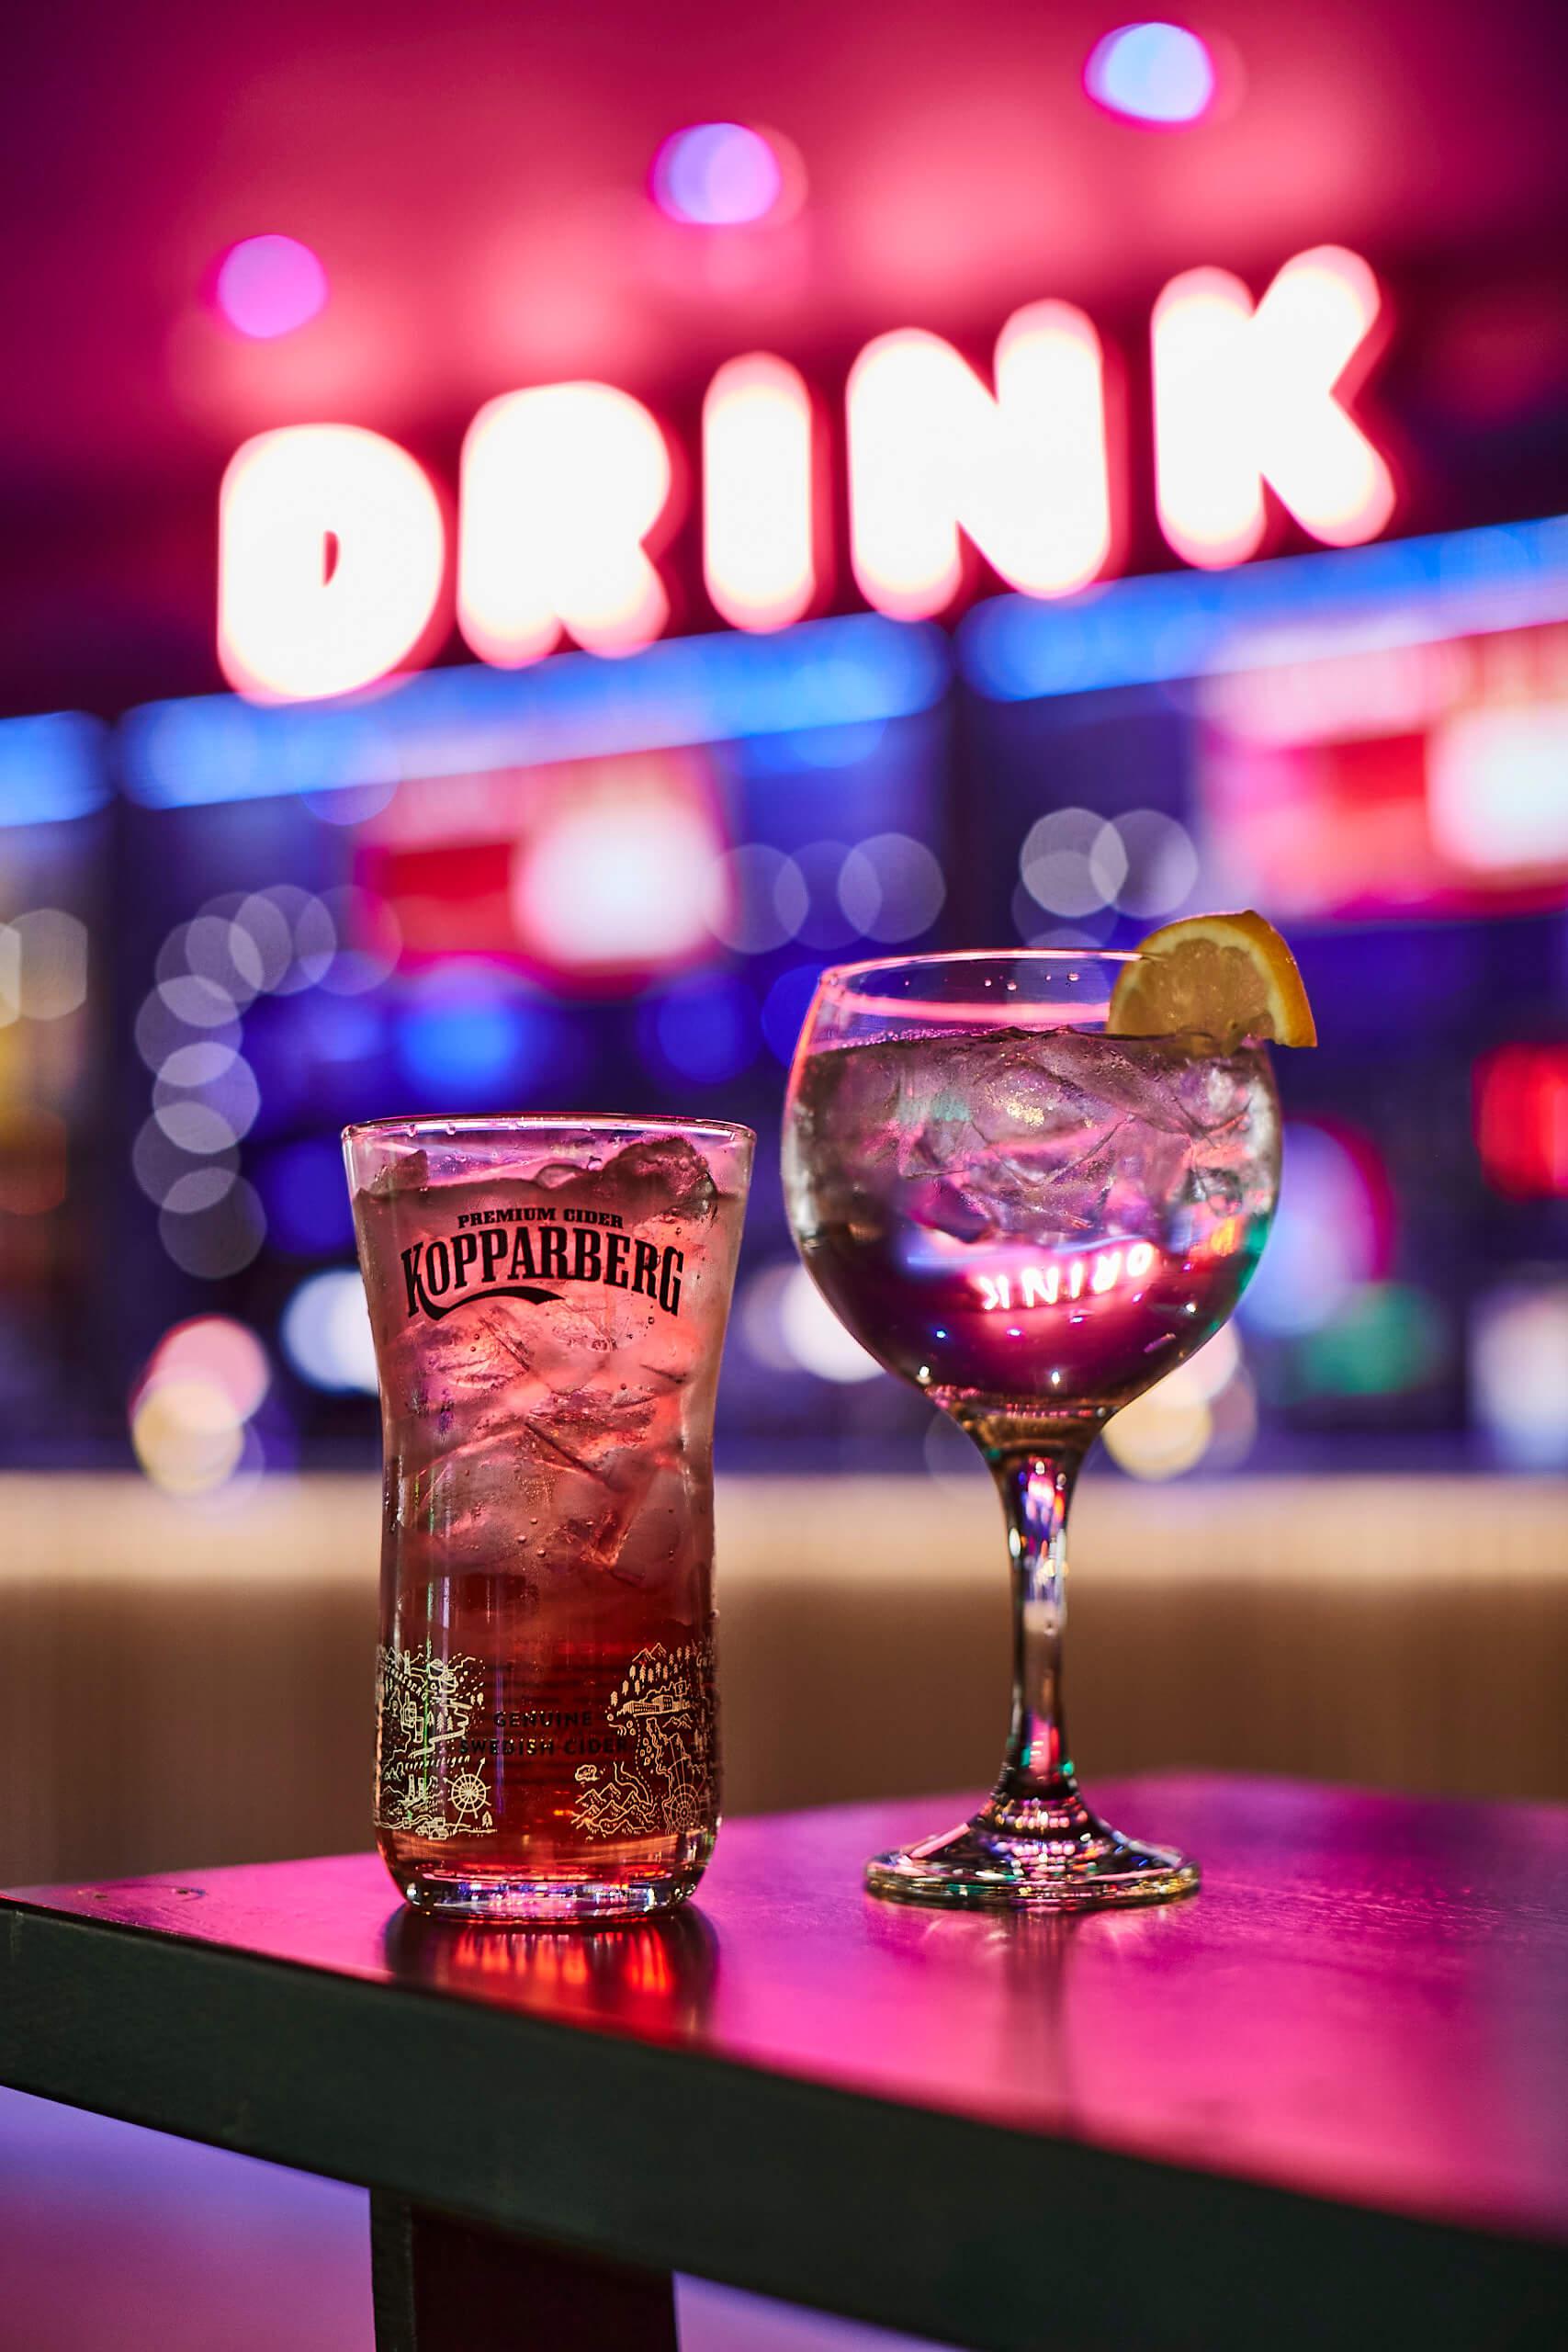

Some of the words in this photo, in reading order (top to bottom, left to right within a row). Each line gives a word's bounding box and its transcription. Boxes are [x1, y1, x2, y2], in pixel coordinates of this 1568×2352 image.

[217, 244, 1396, 706] DRINK
[457, 1208, 556, 1229] PREMIUM
[563, 1208, 624, 1229] CIDER
[400, 1226, 685, 1320] KOPPARBERG
[494, 1711, 593, 1728] GENUINE
[459, 1737, 555, 1757] SWEDISH
[565, 1736, 628, 1756] CIDER
